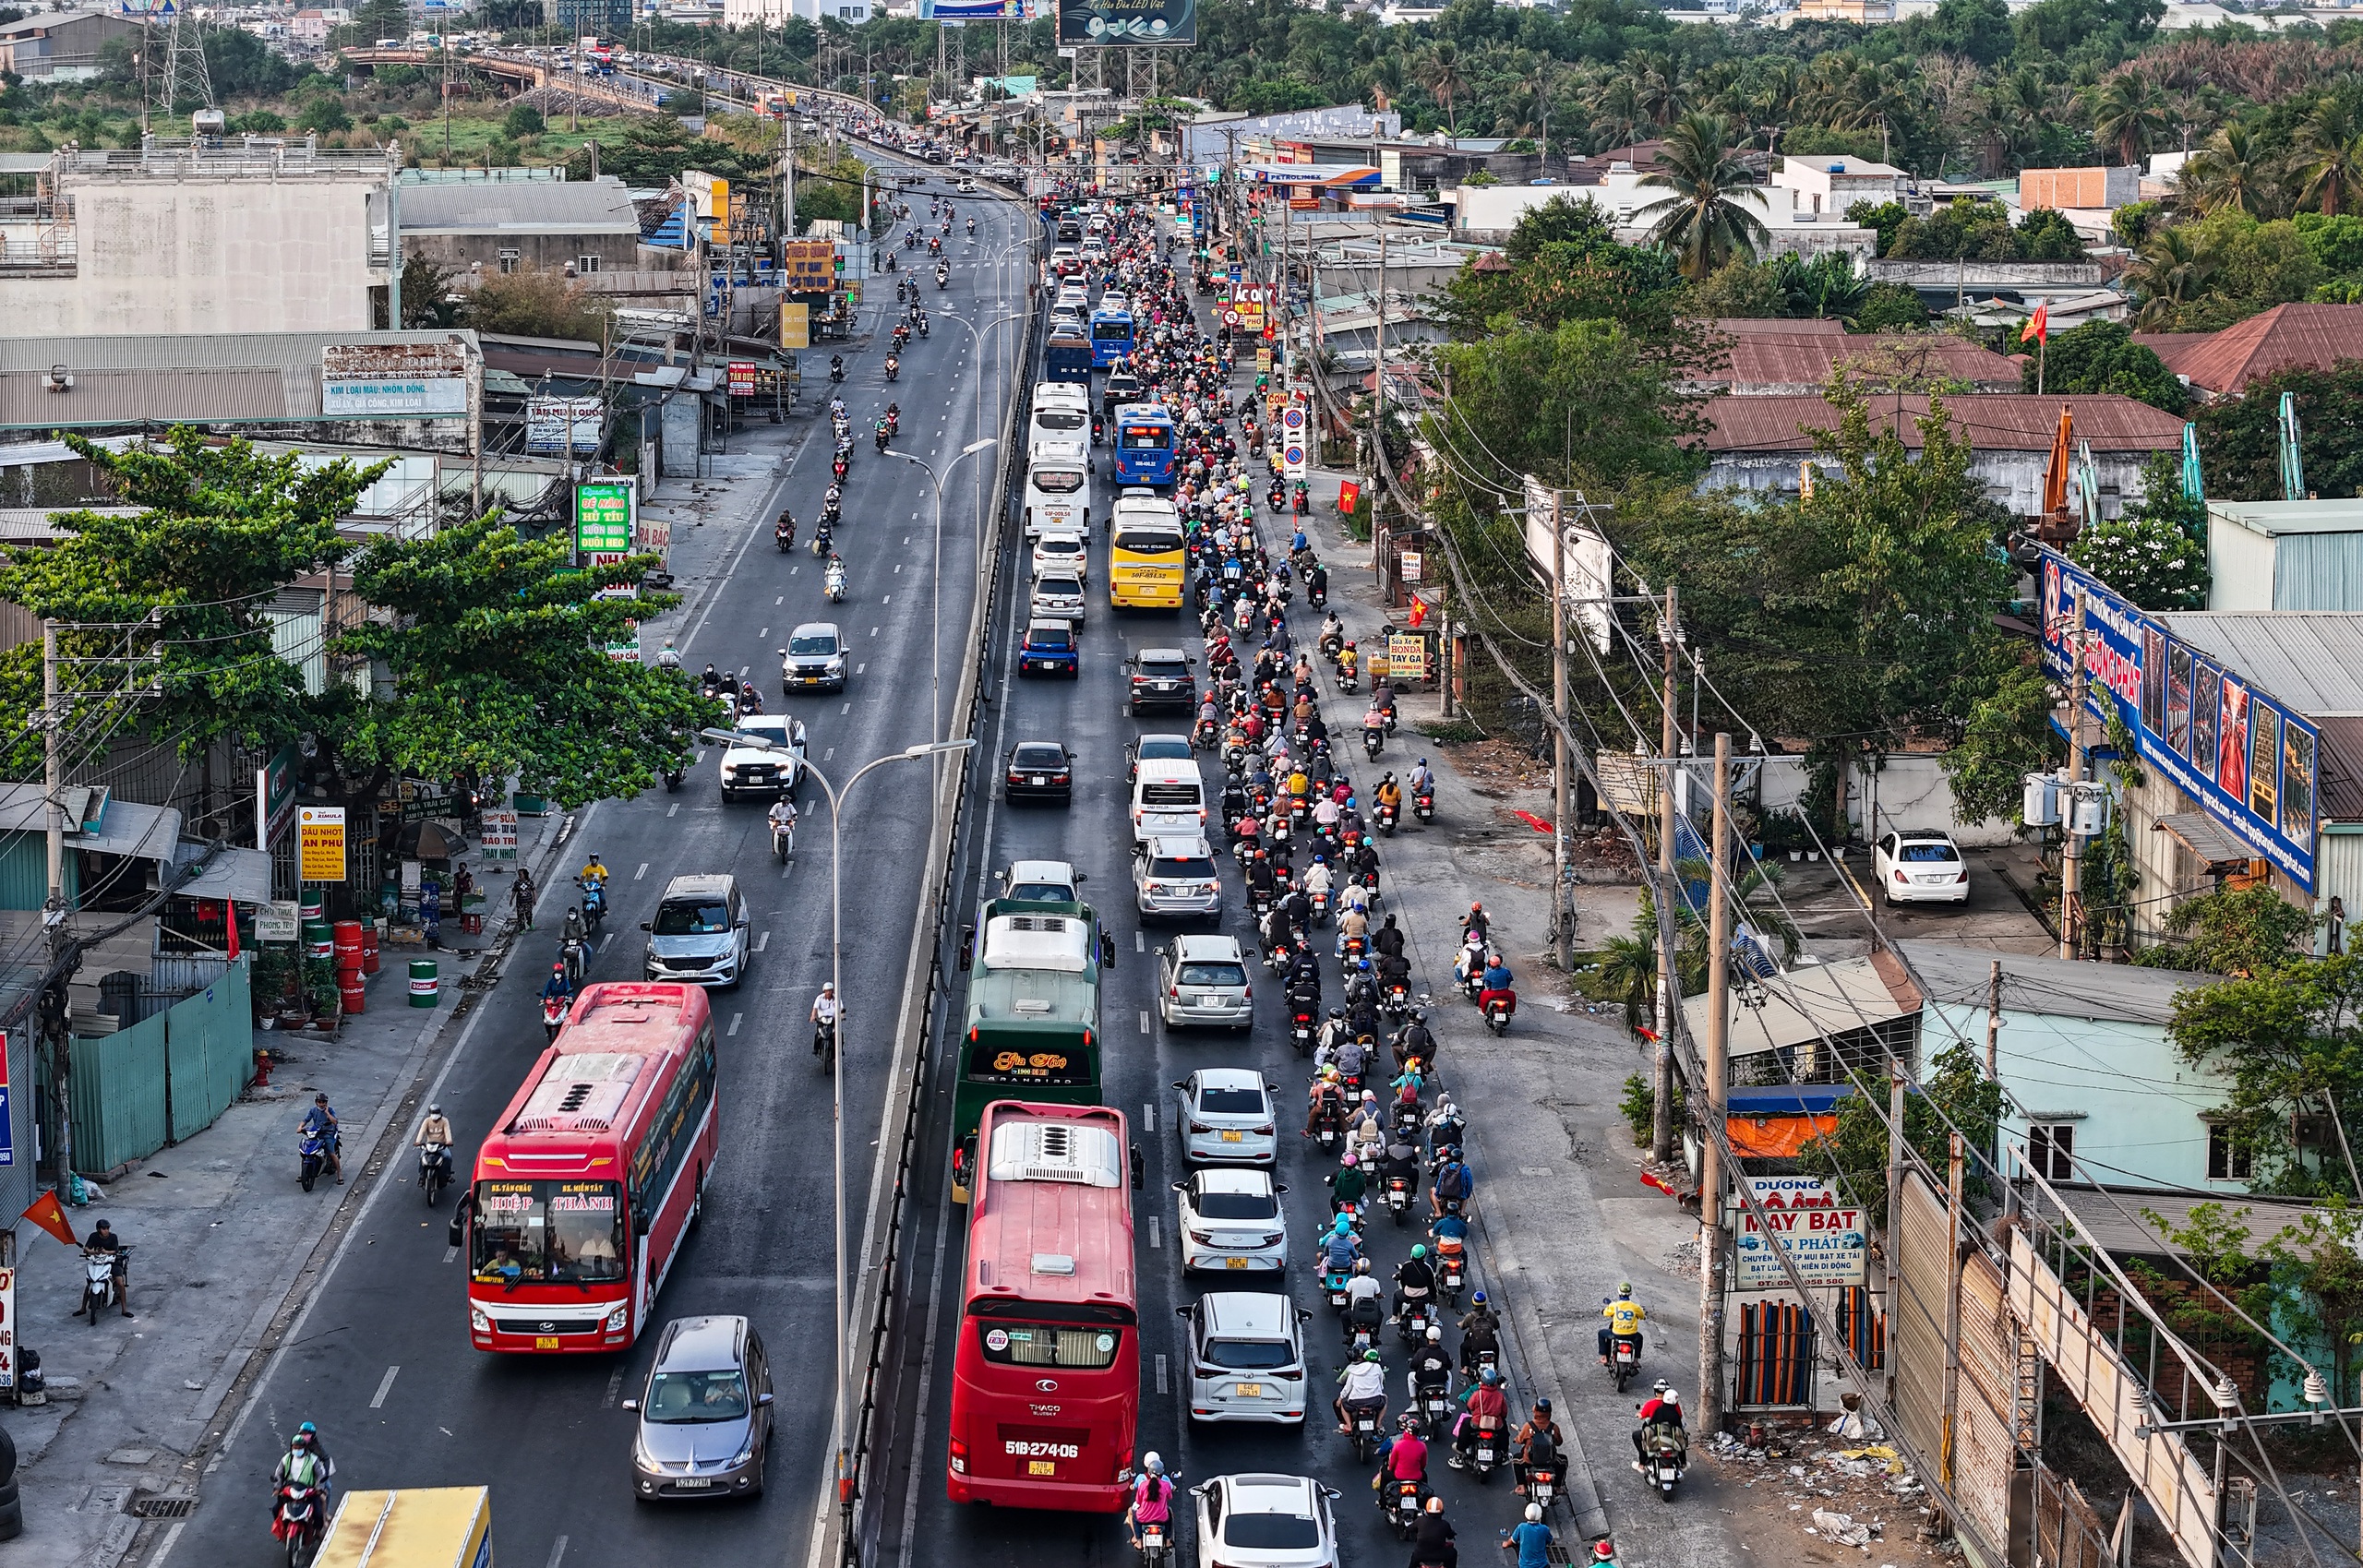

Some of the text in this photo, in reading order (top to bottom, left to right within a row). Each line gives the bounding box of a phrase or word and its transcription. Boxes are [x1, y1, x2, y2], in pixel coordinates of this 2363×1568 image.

[330, 387, 343, 395] KIM
[346, 386, 361, 395] LOẠI
[390, 399, 403, 407] KIM
[1269, 394, 1287, 403] CƠM
[606, 537, 625, 547] HEO
[1405, 637, 1411, 645] Xe
[2116, 652, 2141, 711] PHÁT
[303, 838, 342, 847] AN PHÚ
[482, 848, 498, 859] THAY
[1755, 1179, 1821, 1191] DƯƠNG
[491, 1191, 614, 1214] HIỆP THÀNH
[1809, 1211, 1857, 1235] BẠT
[1798, 1235, 1841, 1250] PHÁT
[1742, 1253, 1772, 1263] CHUYÊN
[1830, 1262, 1852, 1271] ĐỘNG
[1616, 1306, 1634, 1321] be
